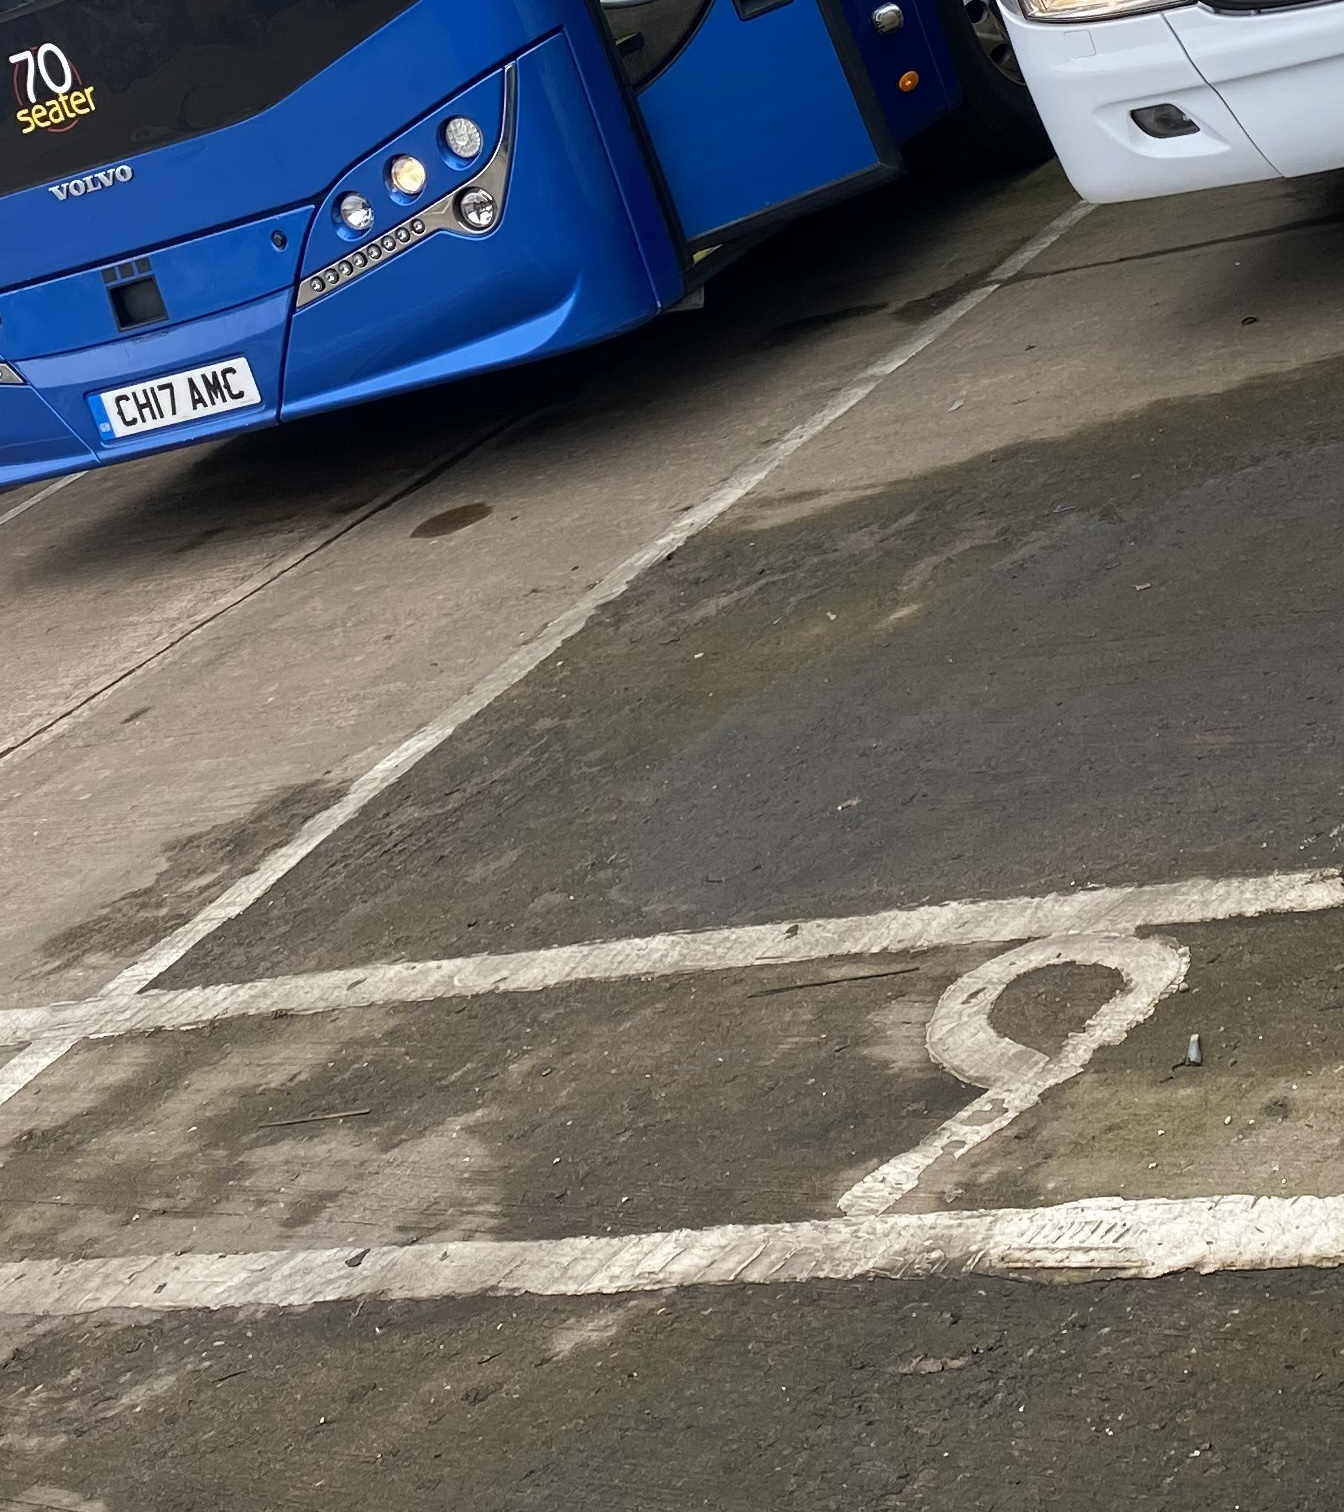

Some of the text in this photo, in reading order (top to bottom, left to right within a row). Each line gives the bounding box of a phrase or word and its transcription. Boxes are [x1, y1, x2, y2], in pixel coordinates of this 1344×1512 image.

[8, 42, 72, 104] 70
[16, 85, 96, 134] seater
[48, 165, 134, 201] VOLVO
[114, 366, 245, 427] CH17 AMC
